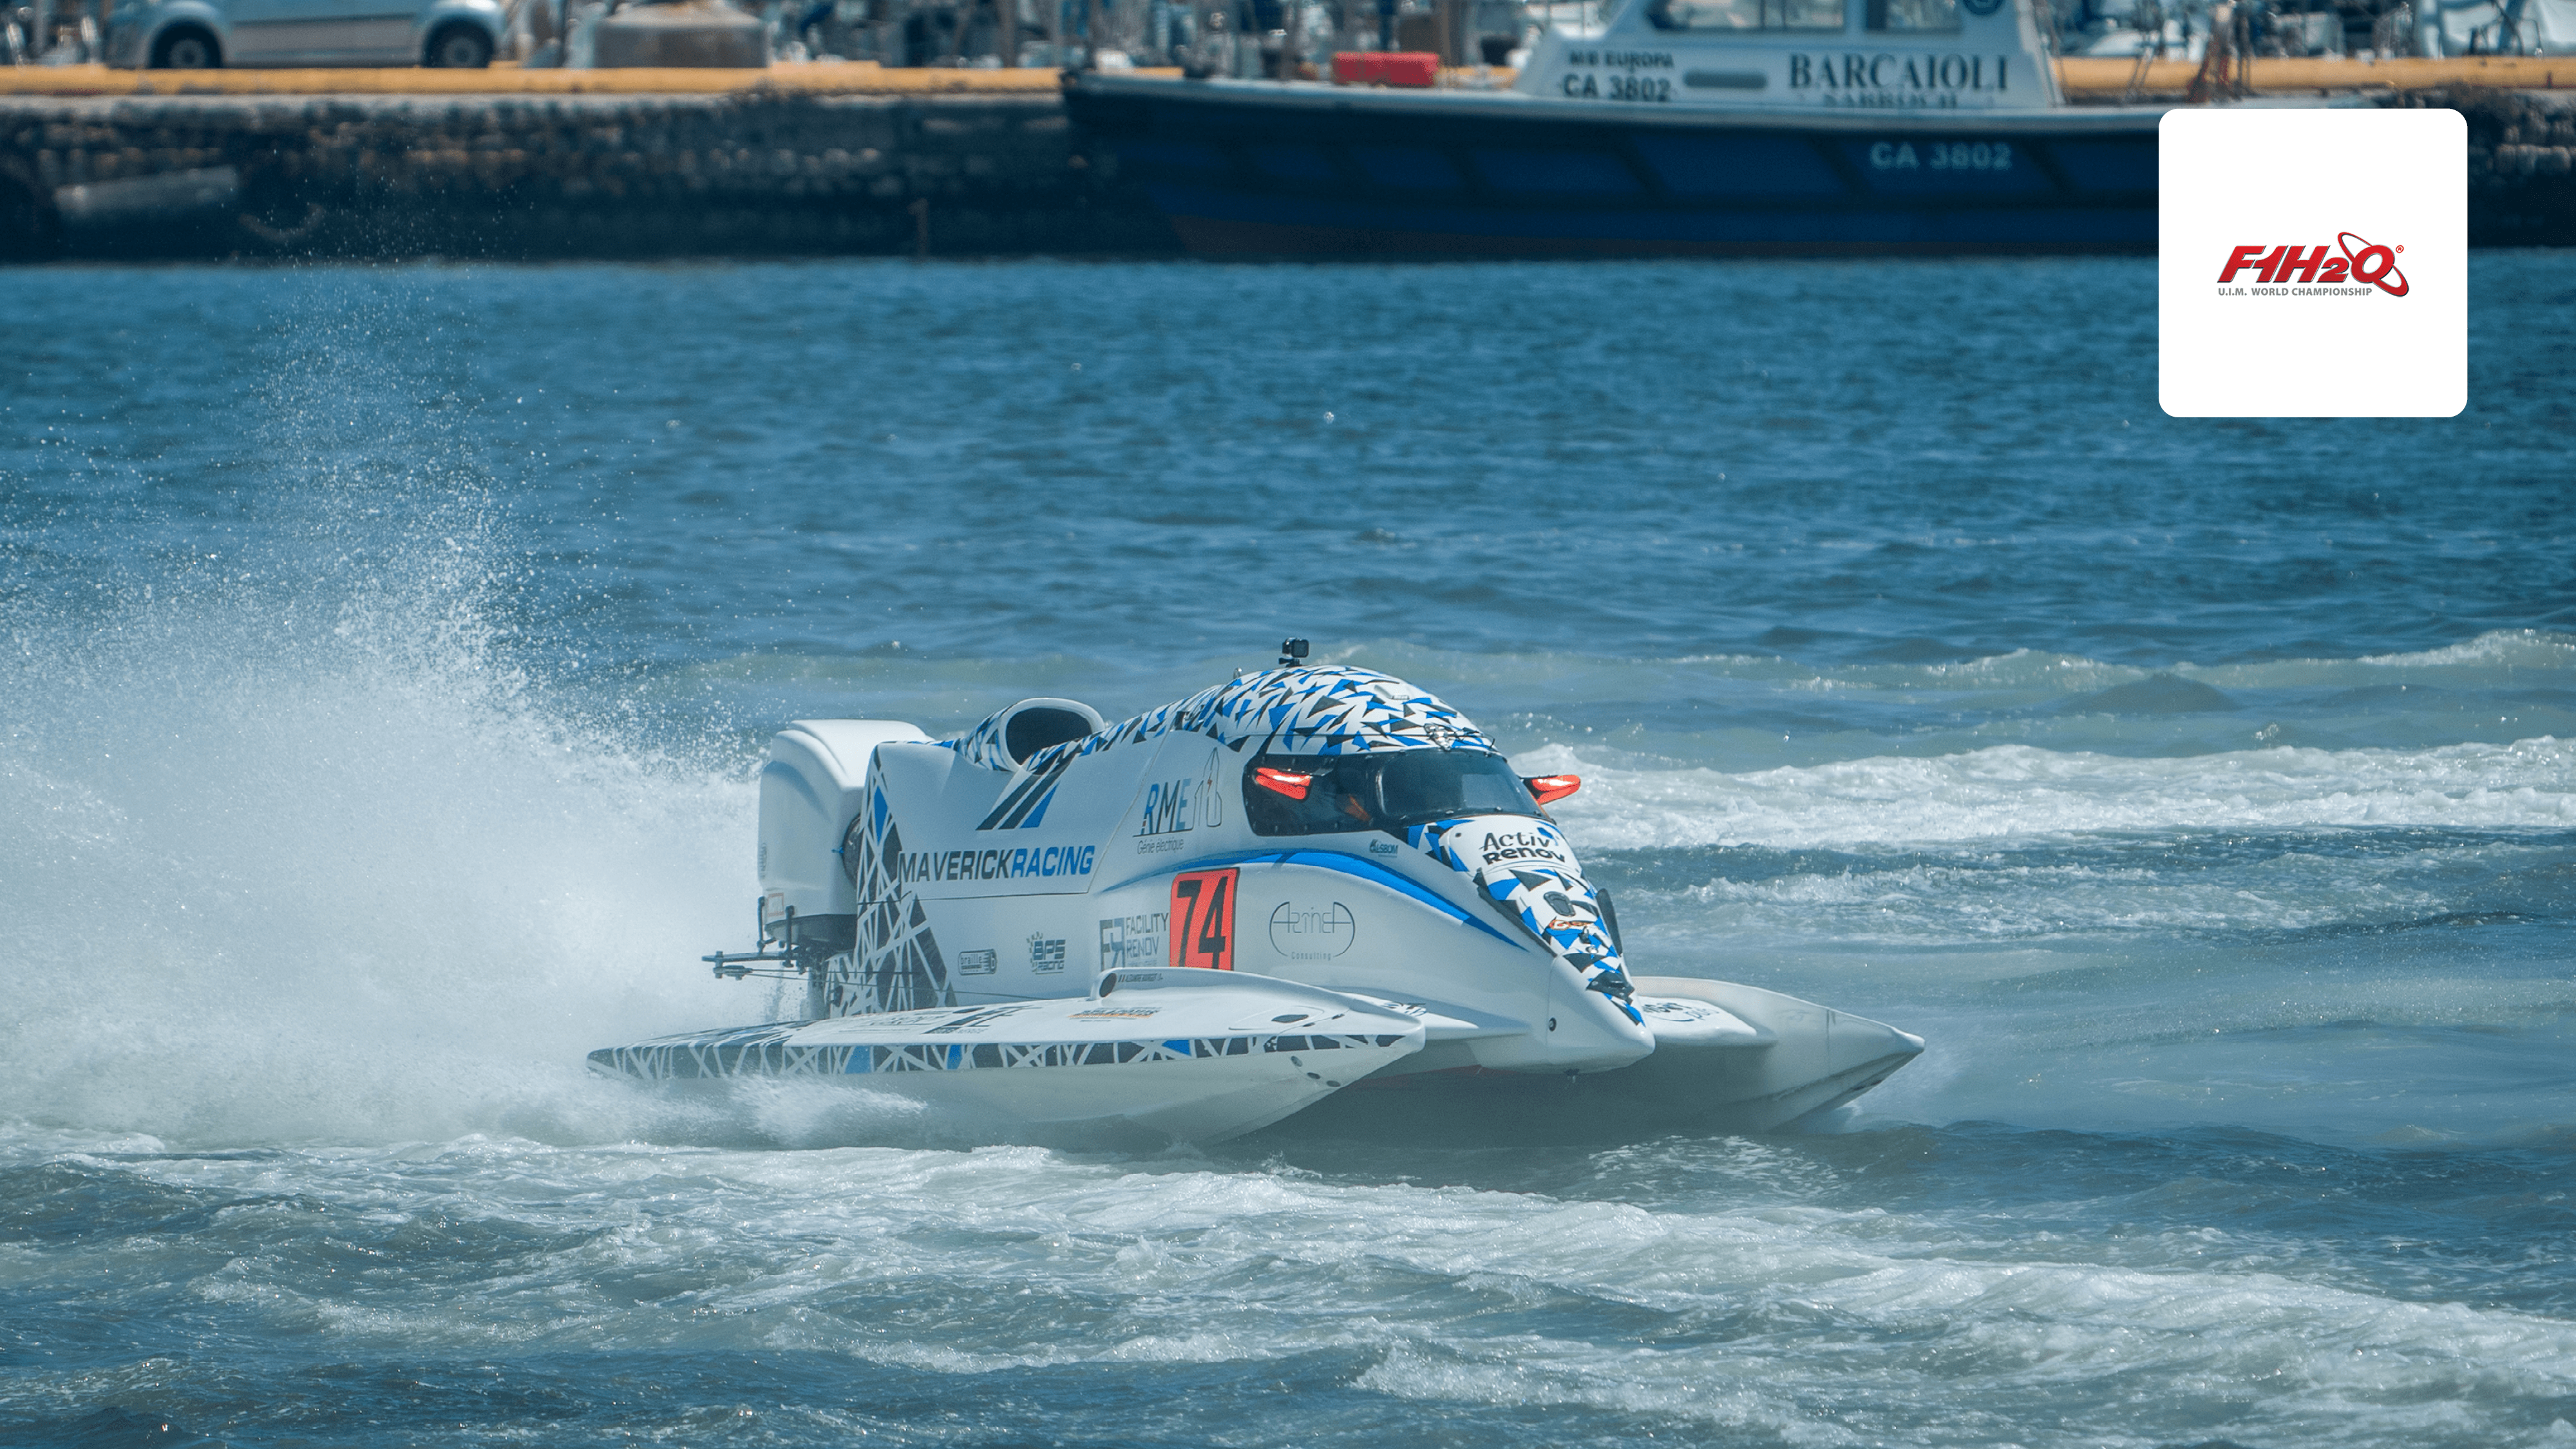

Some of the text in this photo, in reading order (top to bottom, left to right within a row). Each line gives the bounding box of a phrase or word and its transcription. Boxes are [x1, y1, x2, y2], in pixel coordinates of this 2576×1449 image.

[1605, 50, 1674, 69] EUROPA
[1790, 53, 2007, 91] BARCAIOLI
[1563, 73, 1671, 102] CA 3802
[1869, 141, 2012, 171] CA 3802
[1140, 778, 1191, 835] RME
[1479, 832, 1550, 851] Activ
[1482, 848, 1565, 865] Renov
[1126, 913, 1169, 935] FACILITY
[1177, 876, 1228, 969] 74
[1033, 939, 1066, 960] BPS
[1126, 936, 1159, 958] RENOV
[1291, 951, 1331, 961] Consulting
